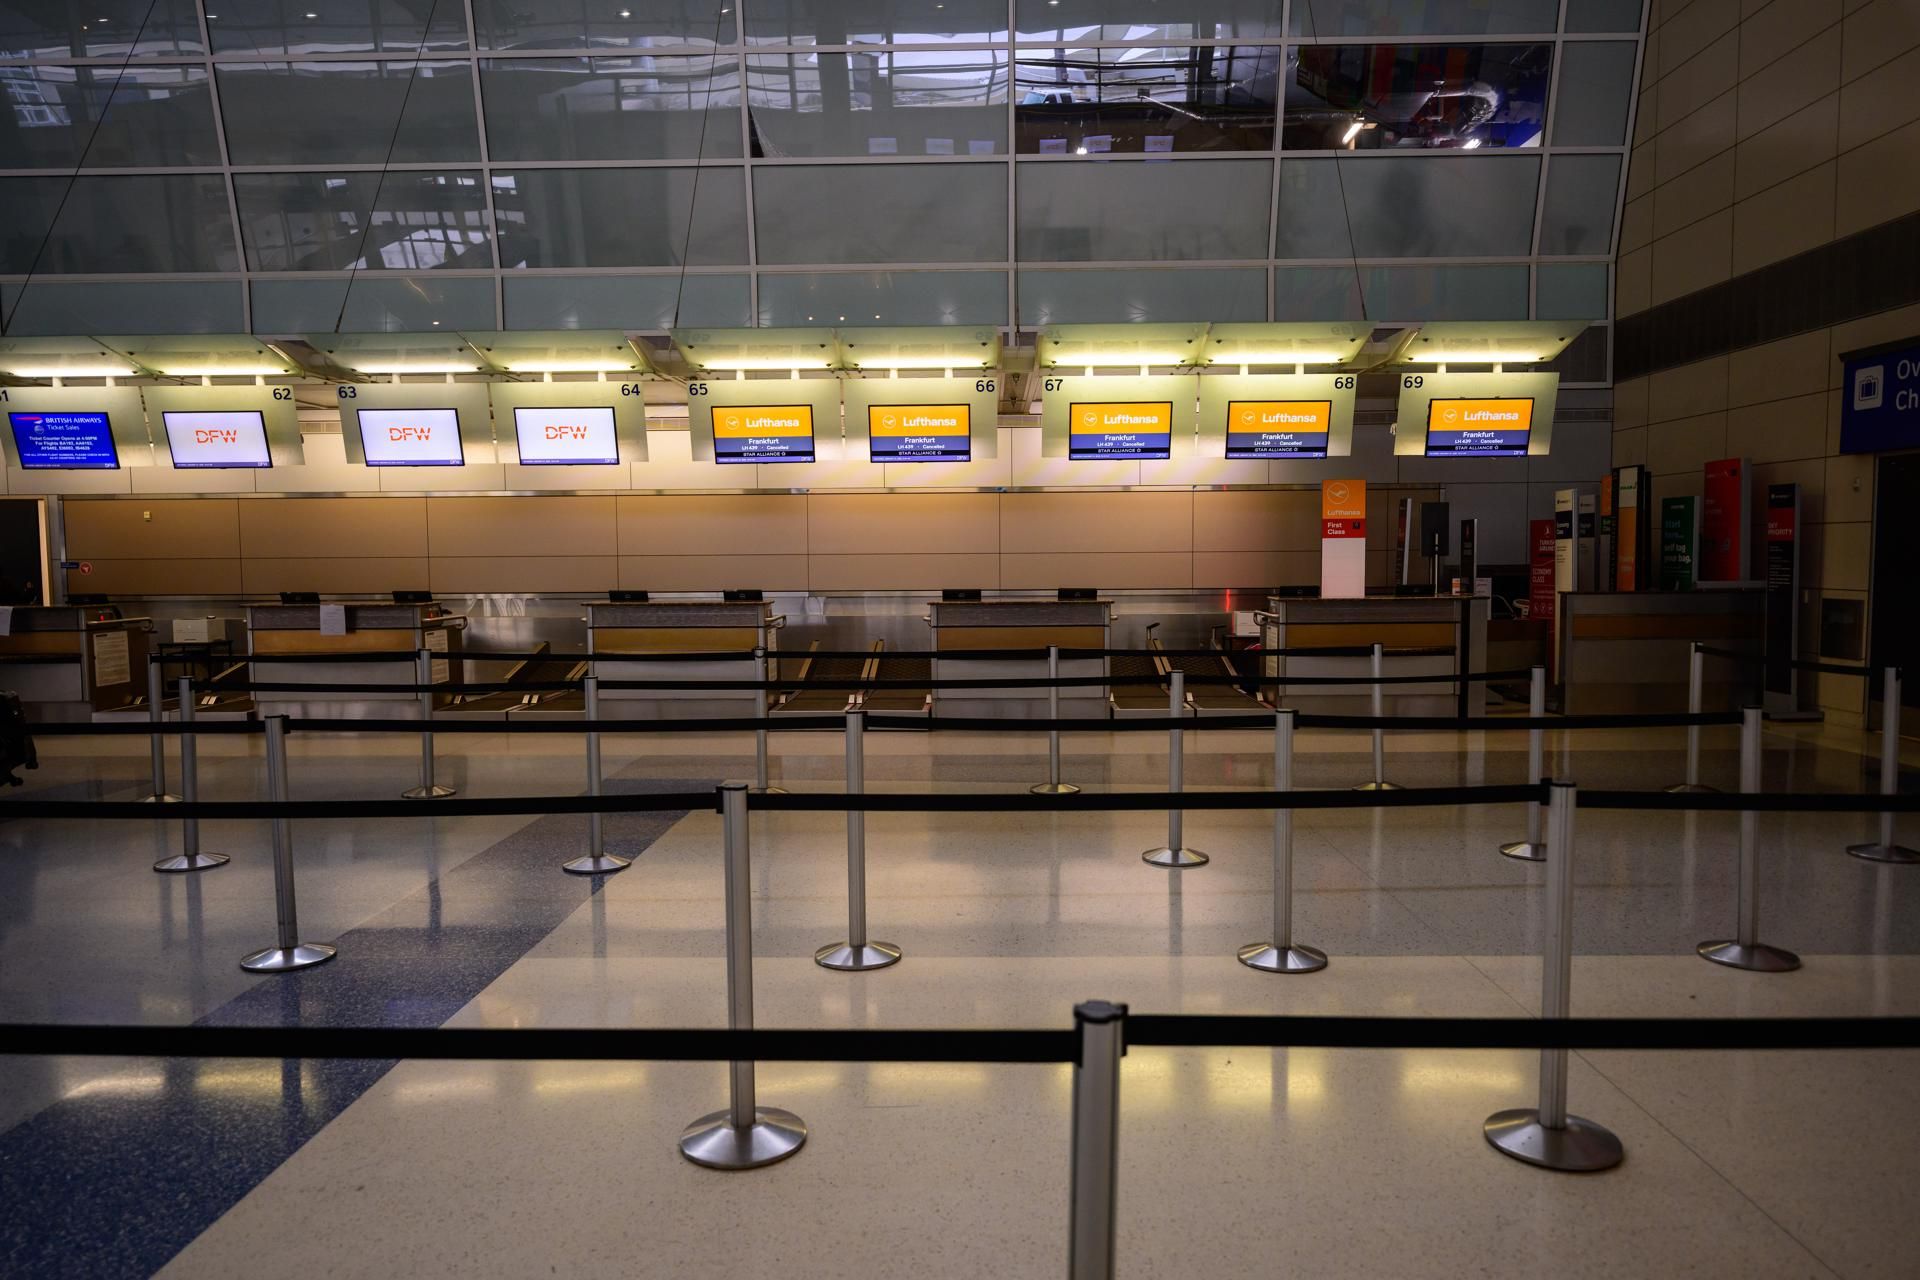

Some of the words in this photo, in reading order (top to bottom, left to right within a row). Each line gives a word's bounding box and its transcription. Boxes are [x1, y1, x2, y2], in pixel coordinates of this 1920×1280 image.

[976, 380, 995, 392] 66
[1045, 379, 1063, 391] 67
[1335, 377, 1354, 389] 68
[1404, 376, 1423, 389] 69
[273, 388, 292, 400] 62
[338, 386, 357, 399] 63
[621, 384, 640, 396] 64
[689, 383, 708, 395] 65
[0, 389, 9, 402] 1
[903, 416, 957, 427] Lufthansa
[1104, 414, 1158, 424] Lufthansa
[1262, 413, 1317, 423] Lufthansa
[1464, 410, 1519, 421] Lufthansa
[746, 417, 800, 428] Lufthansa
[195, 430, 237, 443] DFW
[389, 427, 431, 441] DFW
[545, 426, 587, 440] DFW
